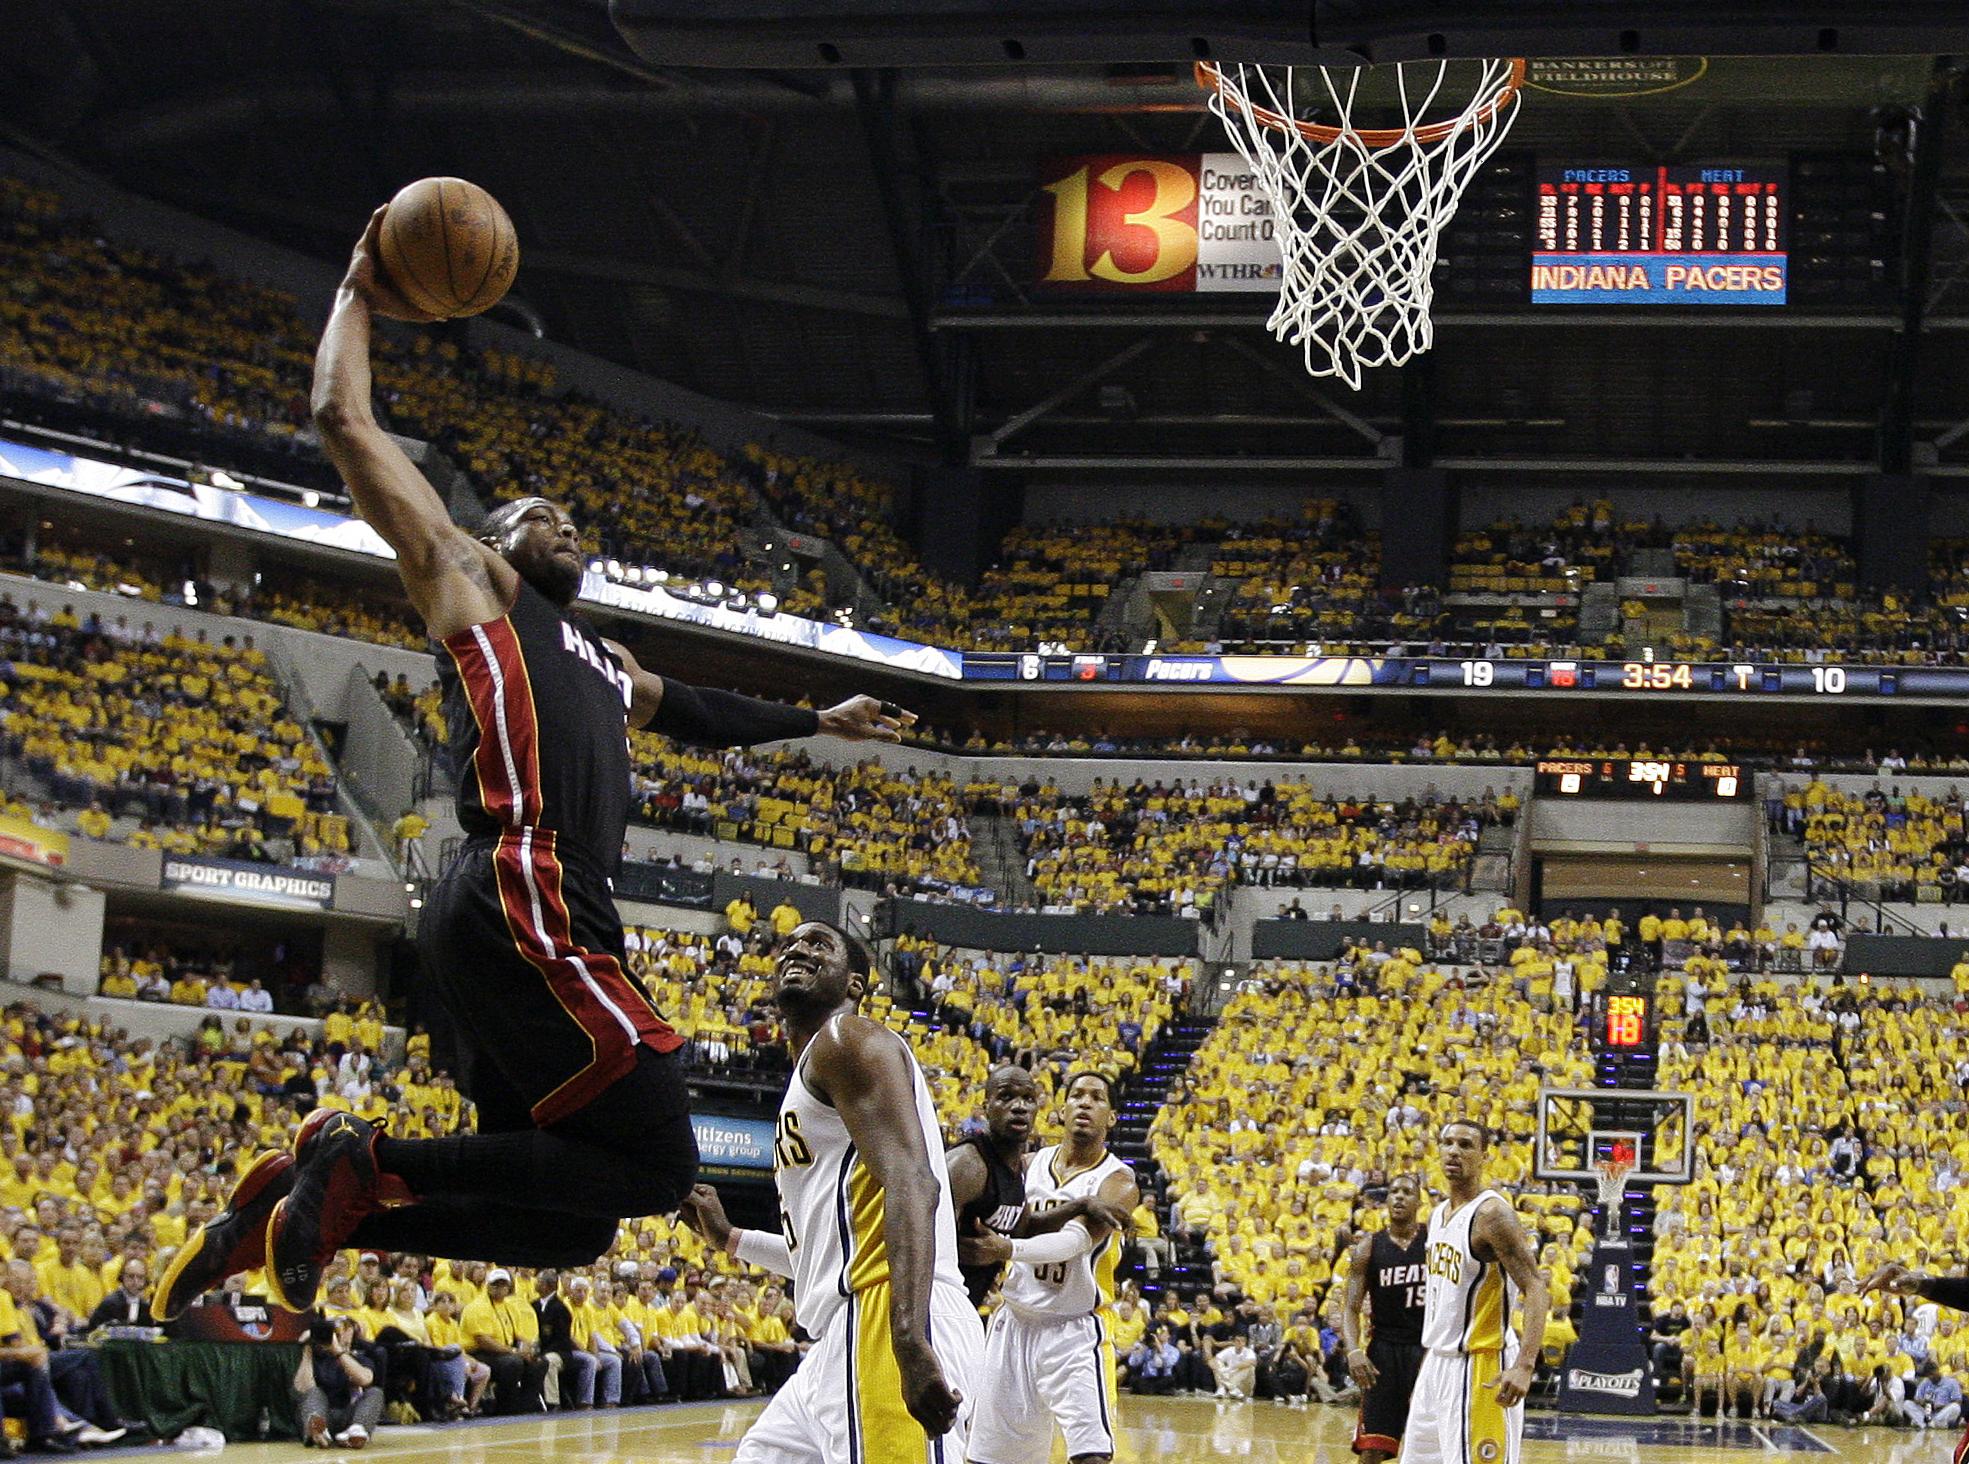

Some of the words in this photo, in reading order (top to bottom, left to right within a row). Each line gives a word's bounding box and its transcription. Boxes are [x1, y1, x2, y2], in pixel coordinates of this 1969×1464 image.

[1564, 169, 1630, 182] PACERS
[1701, 169, 1744, 182] HEAT
[1200, 194, 1234, 216] You
[1042, 160, 1197, 284] 13
[1201, 219, 1256, 240] Count
[1197, 263, 1262, 279] WTHR
[1533, 265, 1650, 290] INDIANA
[1665, 265, 1783, 291] PACERS
[1145, 659, 1213, 680] Pacers
[1460, 661, 1494, 687] 19
[1623, 663, 1693, 689] 3:54
[1812, 667, 1846, 693] 10
[1538, 762, 1593, 774] PACERS
[1702, 765, 1740, 777] HEAT
[165, 862, 233, 885] SPORT
[234, 871, 332, 899] GRAPHICS
[1607, 1015, 1643, 1045] 18
[729, 1145, 760, 1159] group
[1615, 1295, 1627, 1307] TV
[1578, 1375, 1640, 1389] PLAYOFFS
